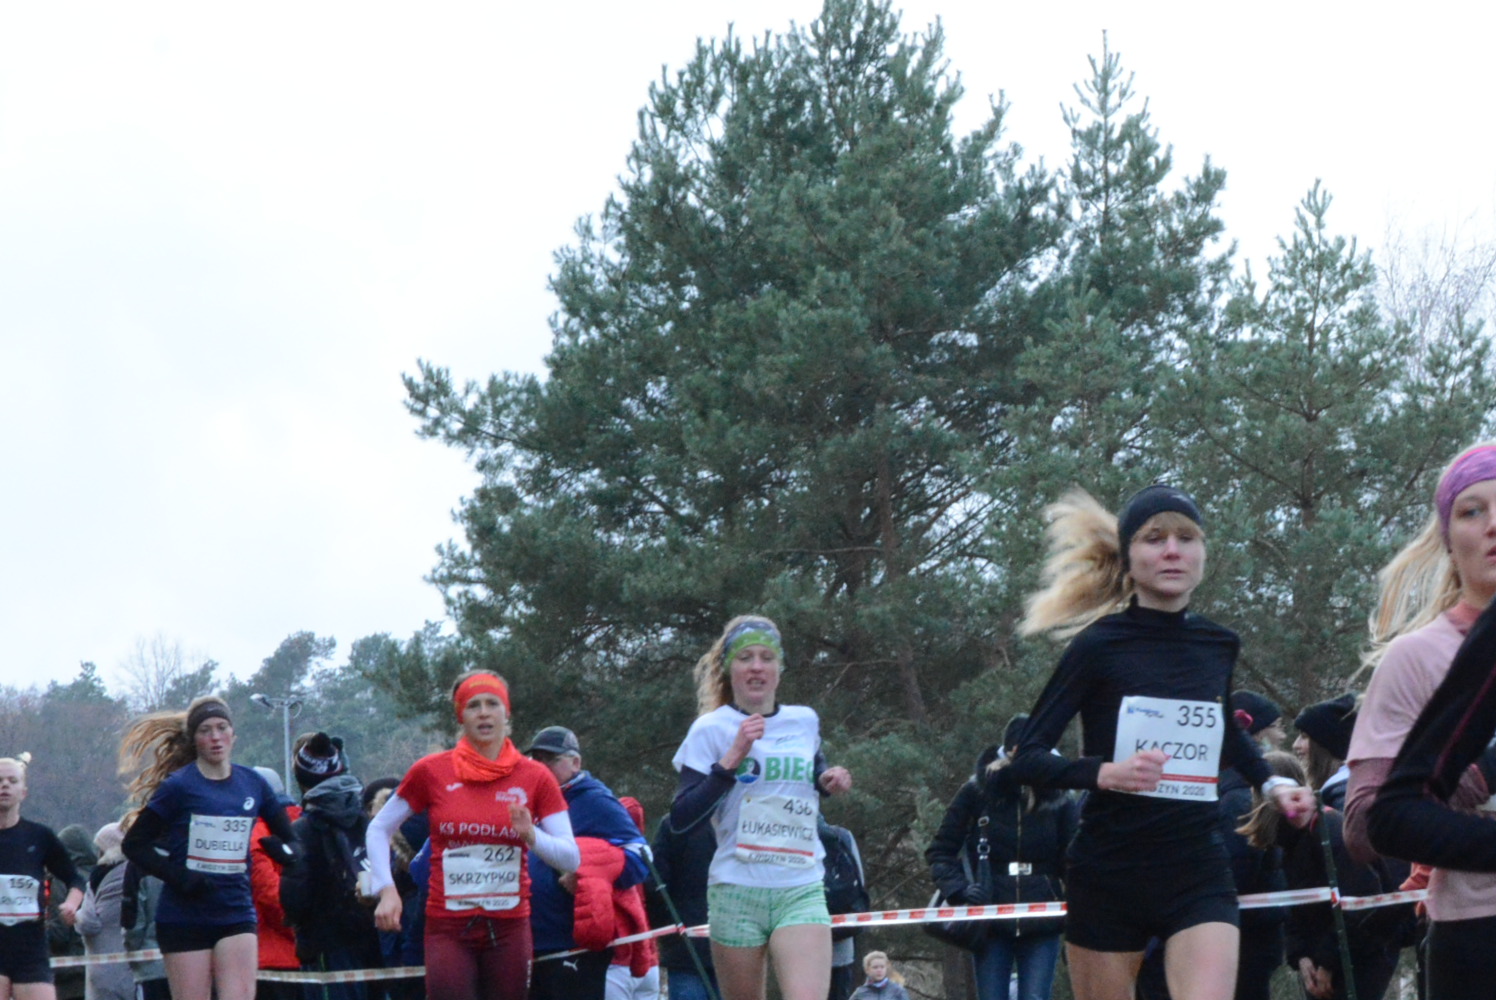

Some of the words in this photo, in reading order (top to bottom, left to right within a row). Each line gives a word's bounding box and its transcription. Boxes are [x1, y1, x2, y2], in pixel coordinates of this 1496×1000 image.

[1177, 705, 1217, 728] 355
[223, 819, 248, 832] 335
[440, 822, 455, 835] KS
[195, 838, 243, 852] DUBIELLA
[483, 845, 516, 862] 262
